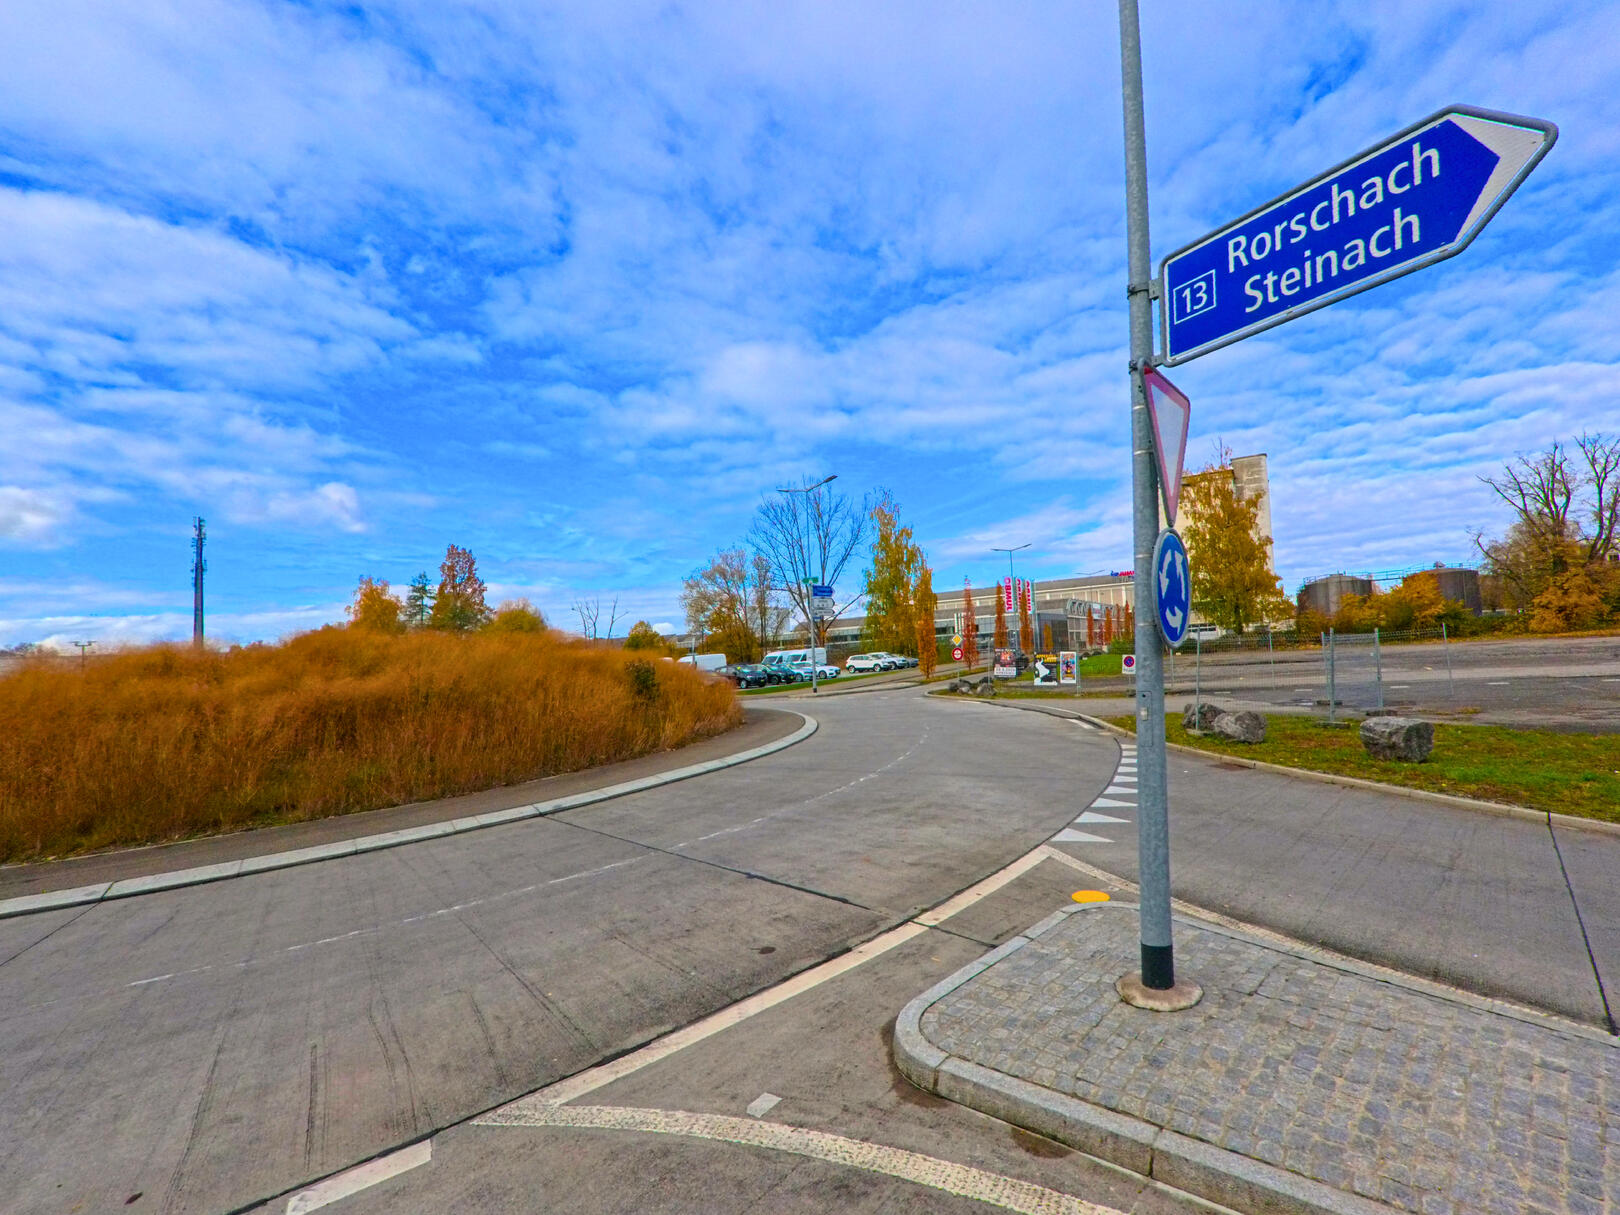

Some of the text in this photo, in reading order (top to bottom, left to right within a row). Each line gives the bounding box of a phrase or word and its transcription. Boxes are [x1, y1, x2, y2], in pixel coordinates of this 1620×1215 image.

[1227, 142, 1440, 273] Rorschach
[1244, 207, 1421, 313] Steinach
[1181, 281, 1208, 314] 13
[1004, 577, 1013, 611] JUMBO
